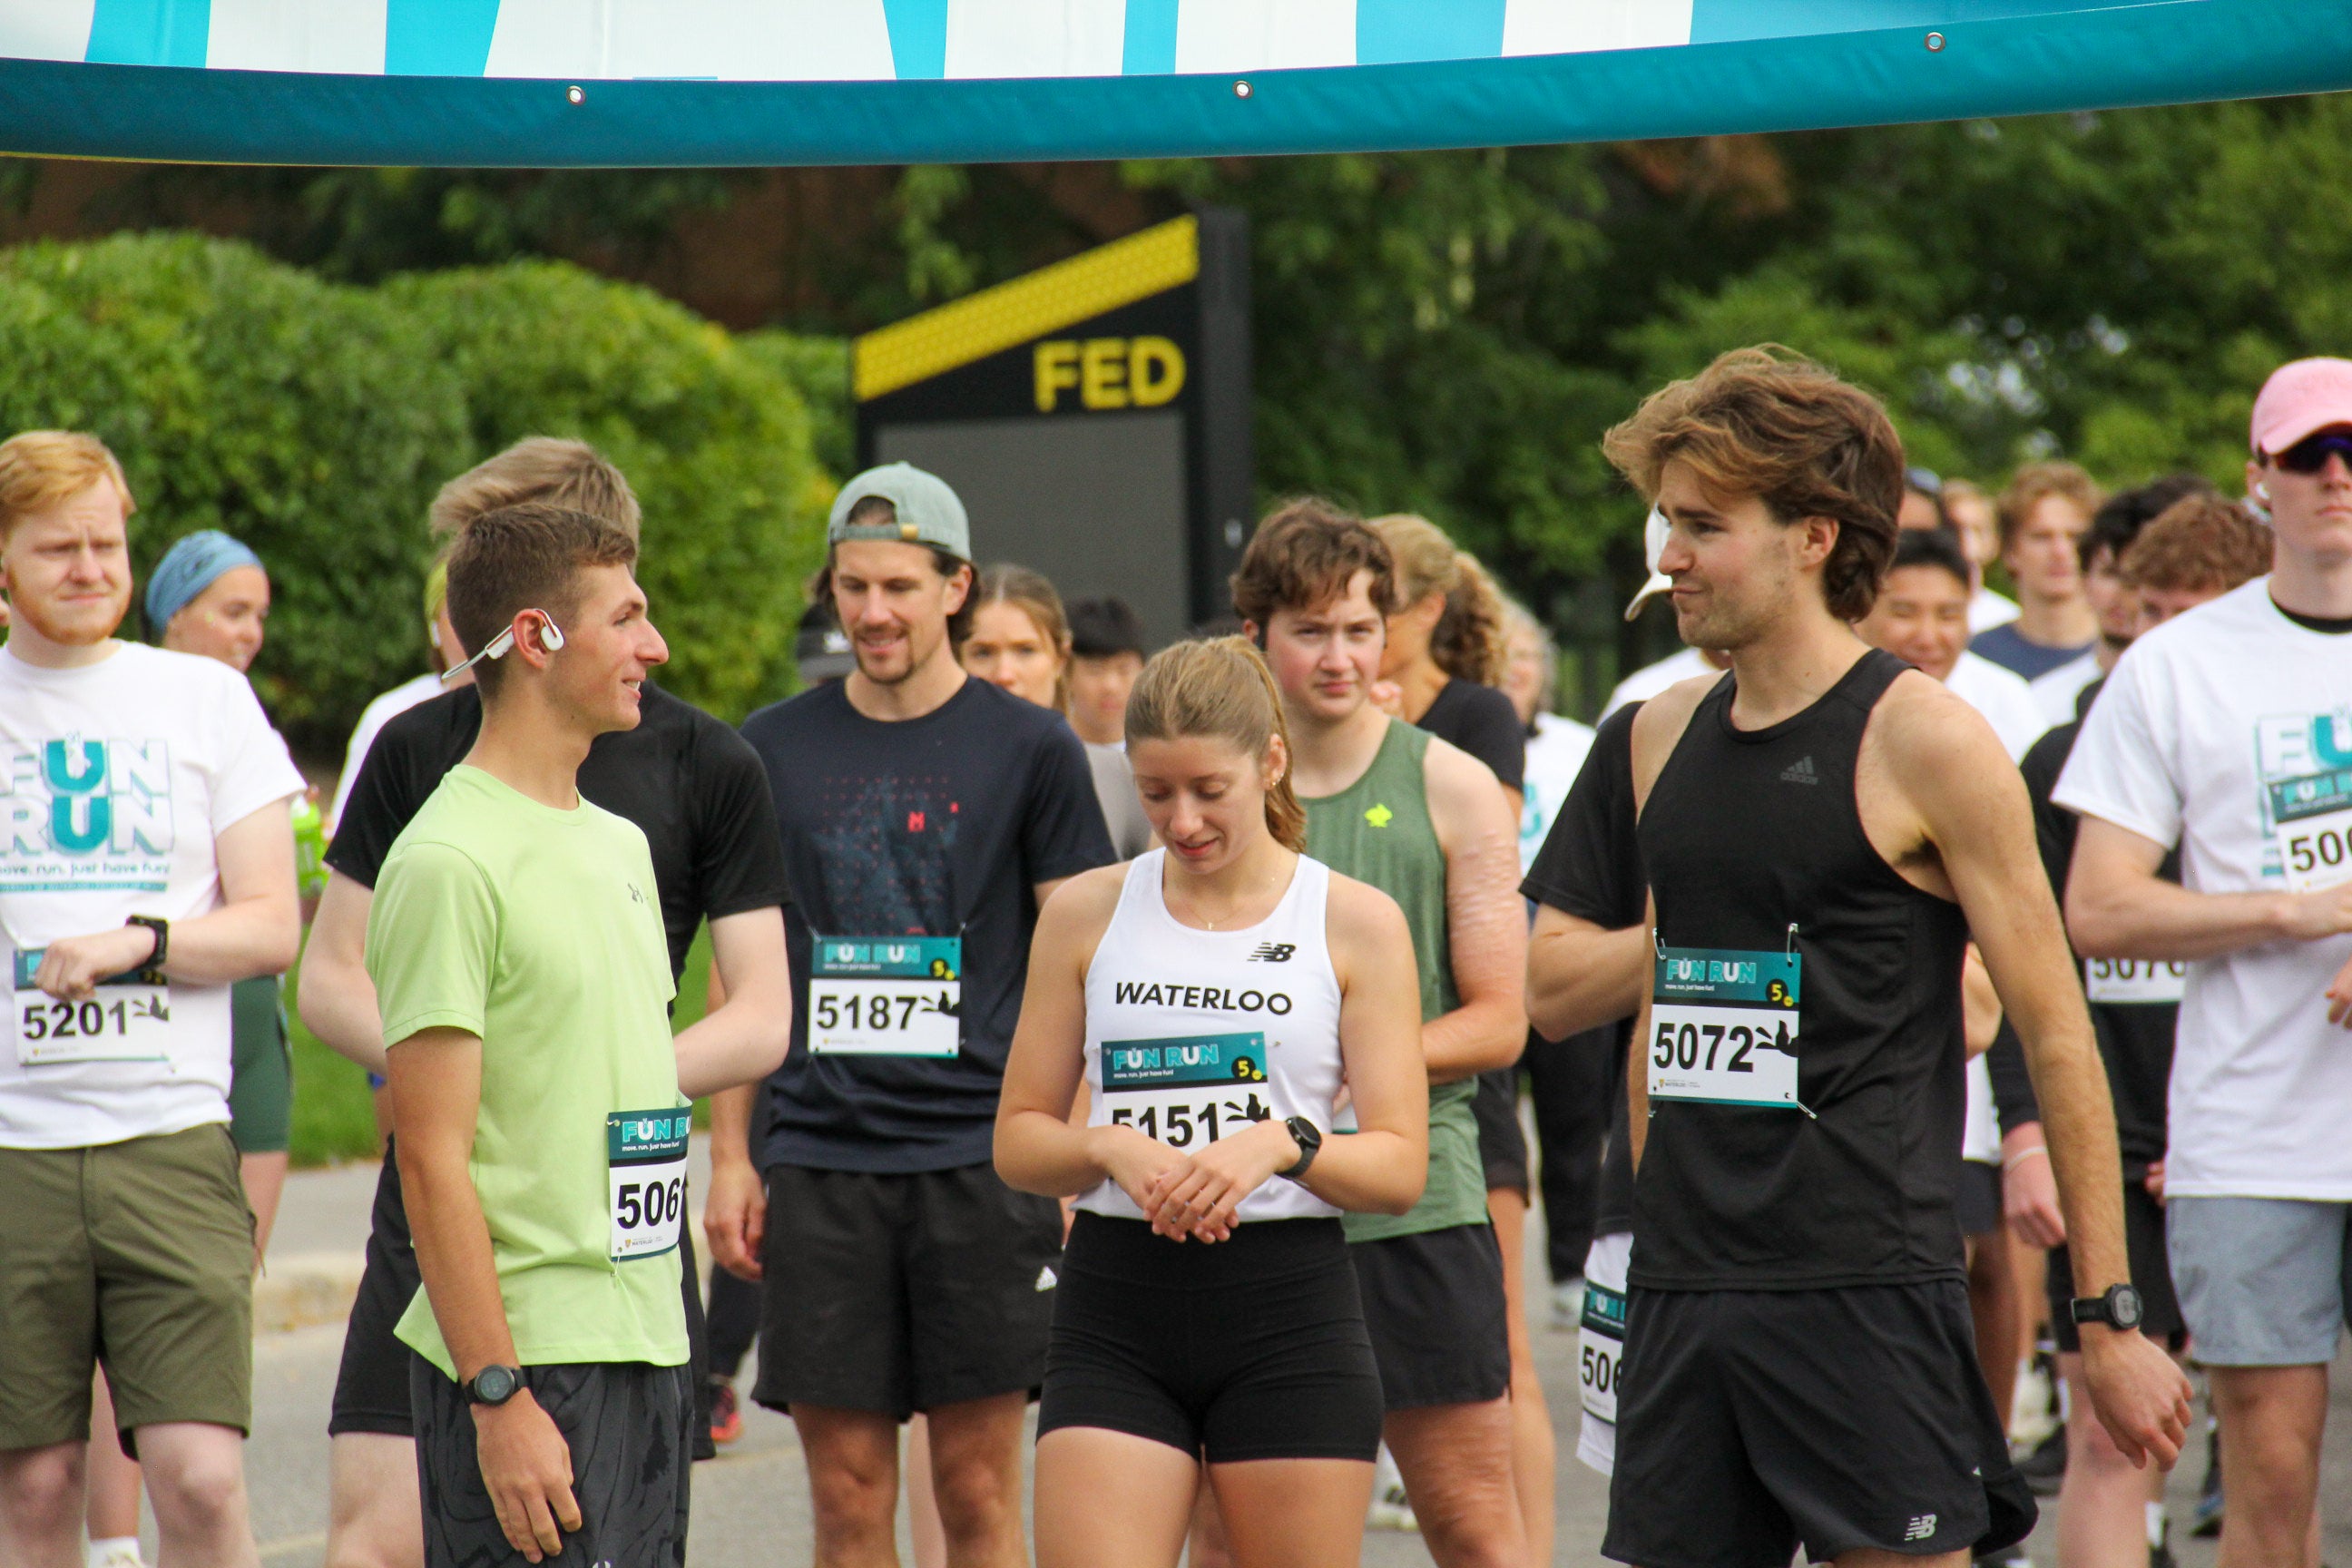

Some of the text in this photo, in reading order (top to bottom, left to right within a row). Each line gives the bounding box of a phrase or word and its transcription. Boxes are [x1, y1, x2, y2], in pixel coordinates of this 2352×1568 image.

[1034, 336, 1187, 413] FED
[1666, 958, 1757, 984] FUN RUN
[1116, 982, 1292, 1015] WATERLOO
[1771, 983, 1783, 1002] 5
[23, 999, 127, 1040] 5201
[817, 994, 919, 1031] 5187
[1113, 1044, 1220, 1071] FUN RUN
[1653, 1023, 1754, 1073] 5072
[1237, 1059, 1250, 1078] 5
[622, 1117, 671, 1143] FUN
[616, 1176, 688, 1230] 506
